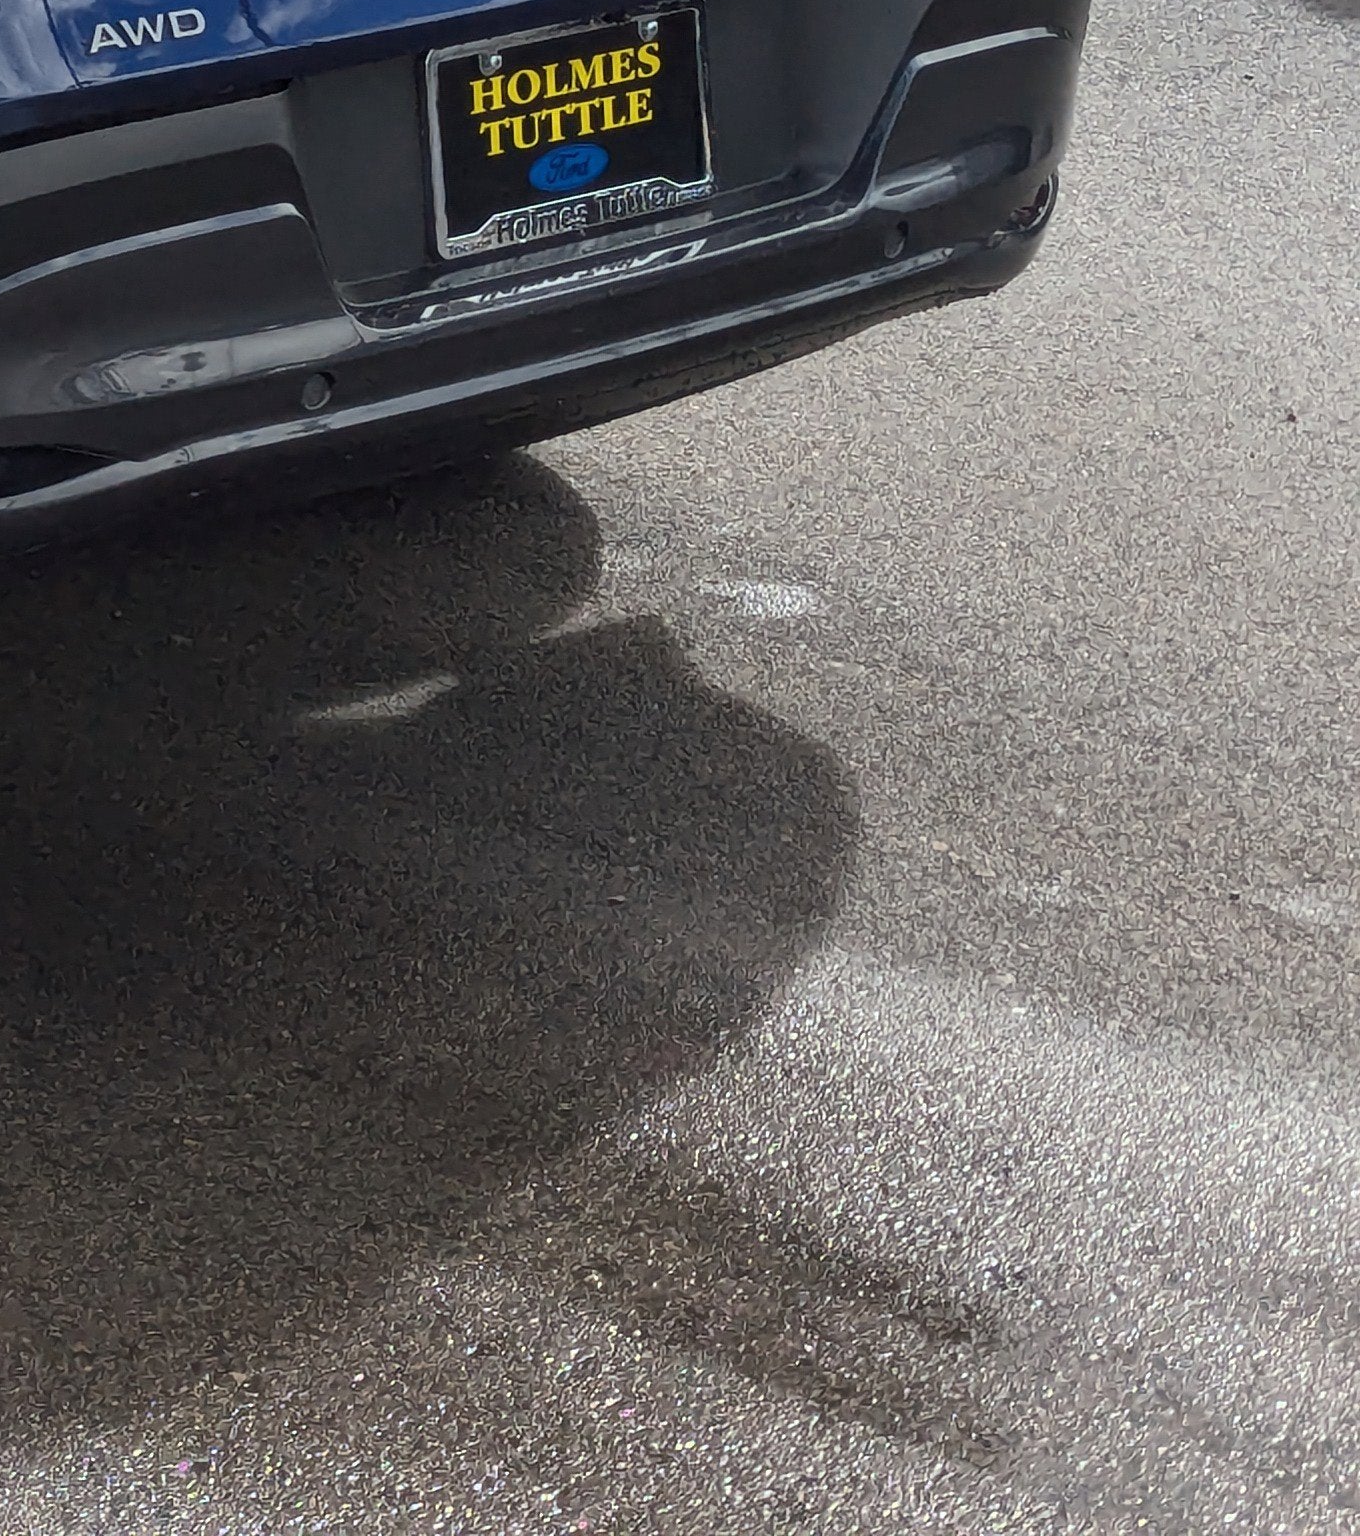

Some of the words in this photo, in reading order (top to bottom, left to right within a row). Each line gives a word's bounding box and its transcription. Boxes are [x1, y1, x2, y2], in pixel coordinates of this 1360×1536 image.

[90, 8, 206, 54] AWD
[470, 42, 661, 115] HOLMES
[479, 88, 653, 156] TUTTLE
[545, 150, 591, 185] Ford
[496, 204, 588, 244] Holmes
[594, 183, 666, 222] Tuttle
